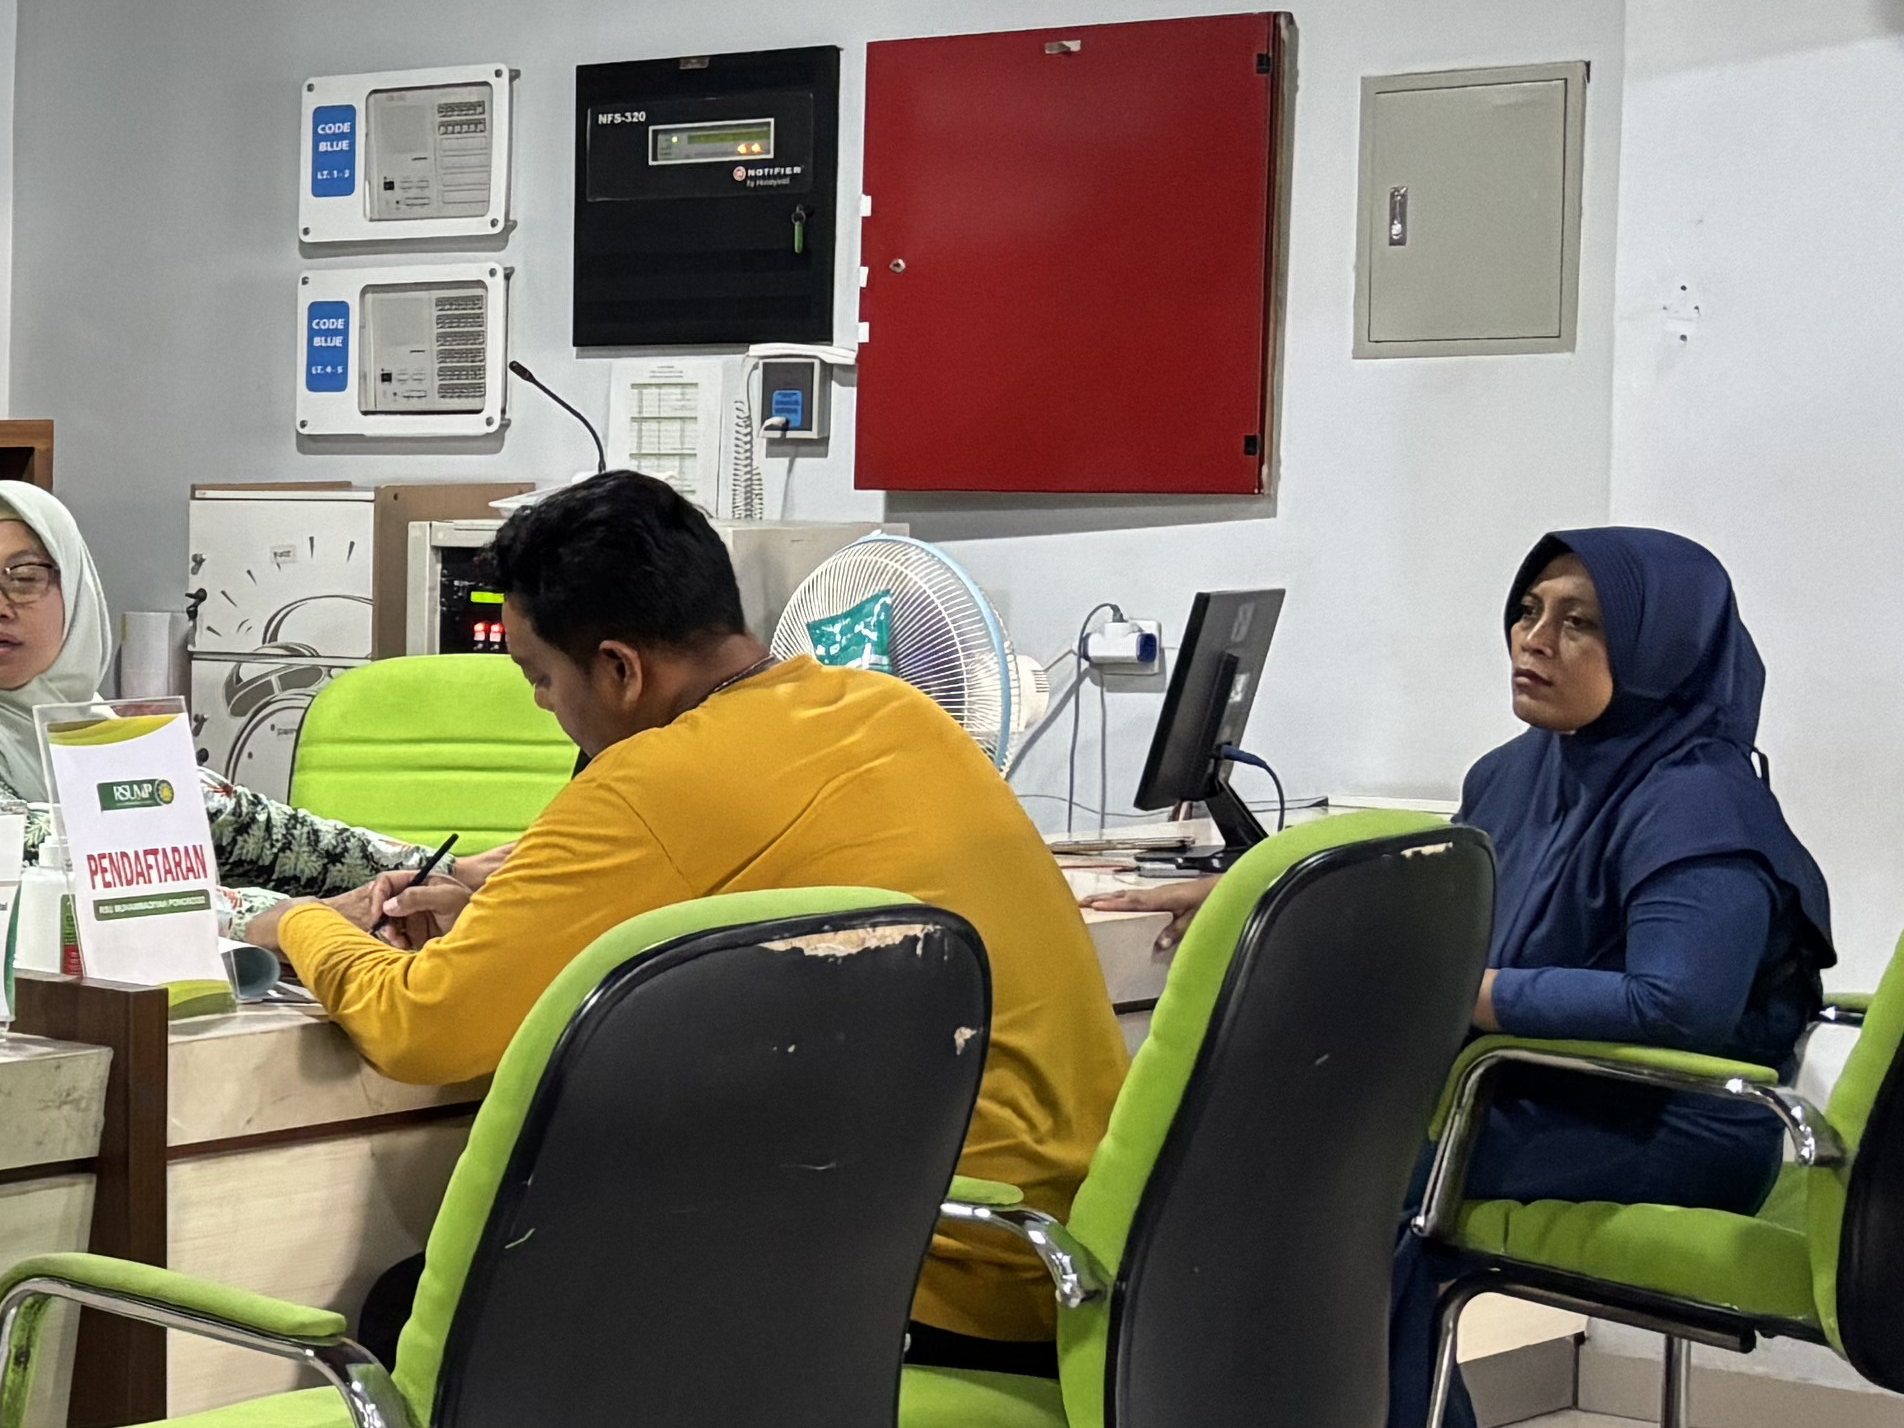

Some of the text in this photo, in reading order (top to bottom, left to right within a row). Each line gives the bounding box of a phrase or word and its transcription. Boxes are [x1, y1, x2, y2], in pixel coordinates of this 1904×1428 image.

[597, 111, 646, 125] NFS-320
[317, 122, 351, 134] CODE
[318, 140, 350, 152] BLUE
[747, 166, 802, 178] NOTIFIER
[312, 318, 344, 330] CODE
[313, 336, 343, 347] BLUE
[86, 844, 208, 890] PENDAFTARAN
